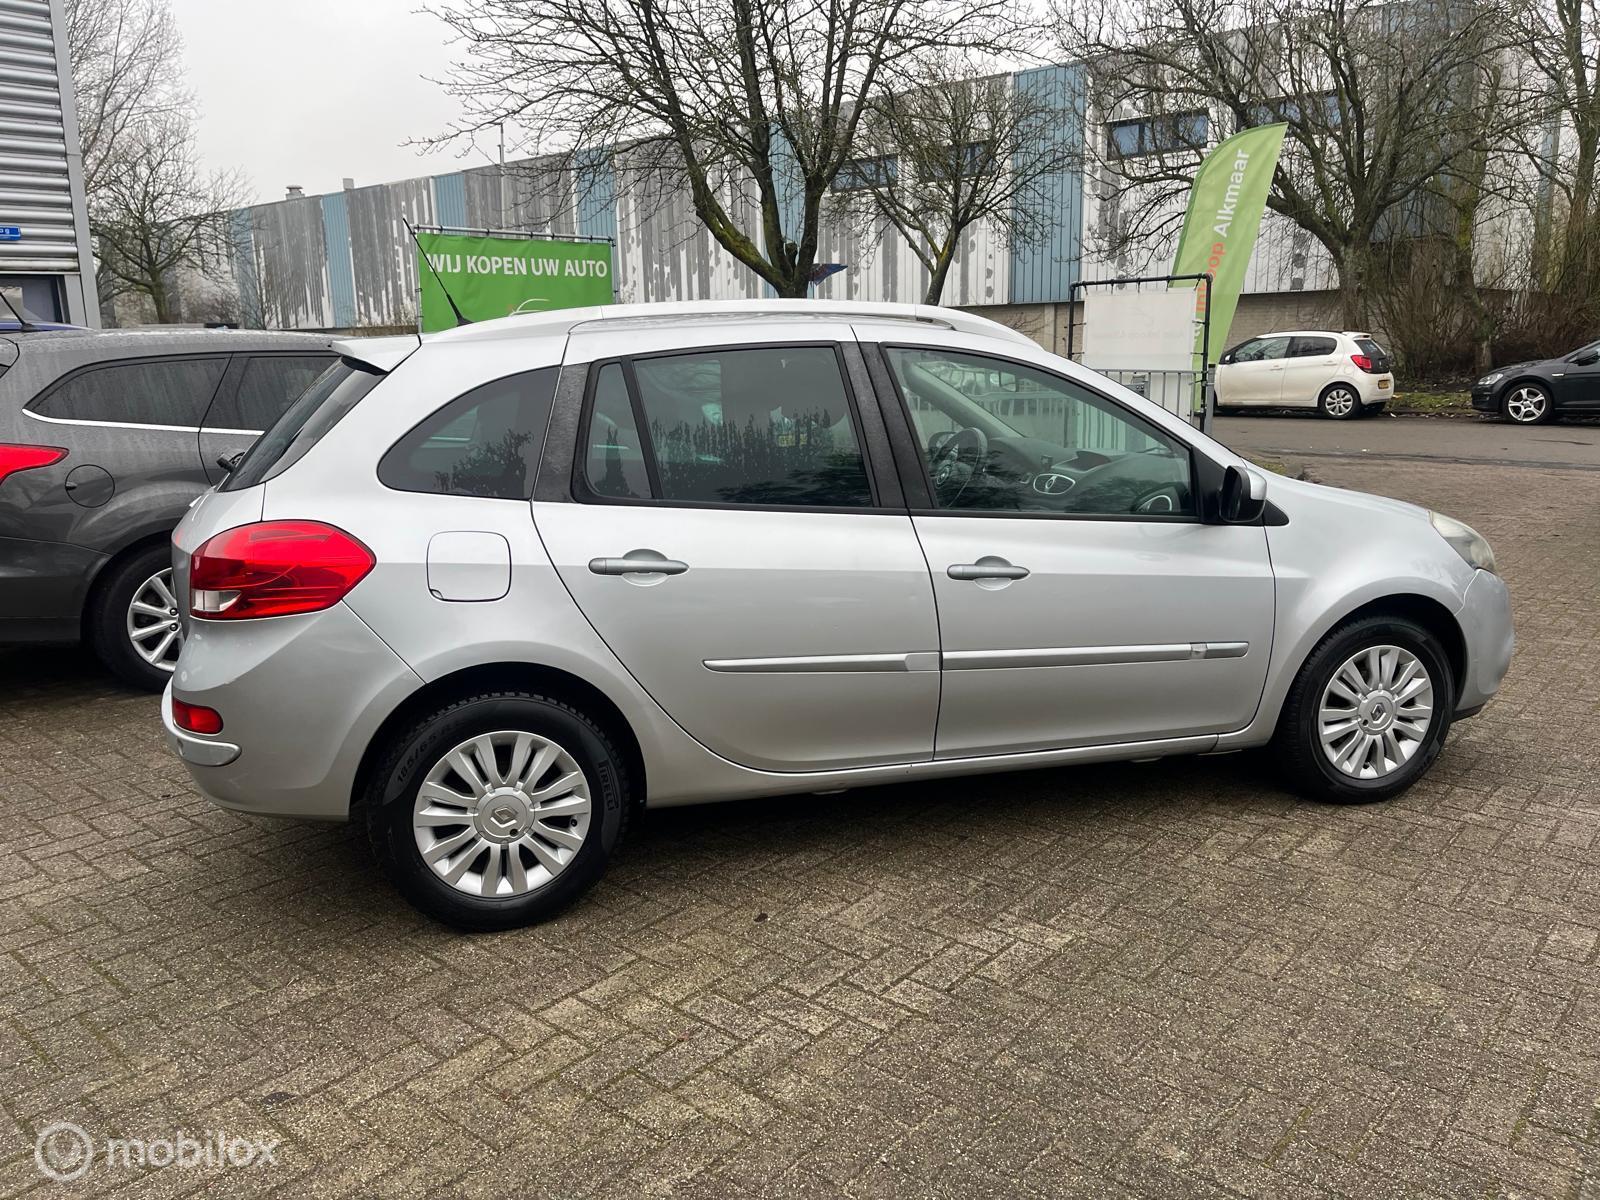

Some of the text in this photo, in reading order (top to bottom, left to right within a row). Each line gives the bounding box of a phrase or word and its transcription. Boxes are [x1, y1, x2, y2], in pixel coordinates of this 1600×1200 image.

[1213, 148, 1250, 238] Alkmaar
[426, 253, 608, 278] WIJ KOPEN UW AUTO
[598, 760, 620, 811] PIRELLI
